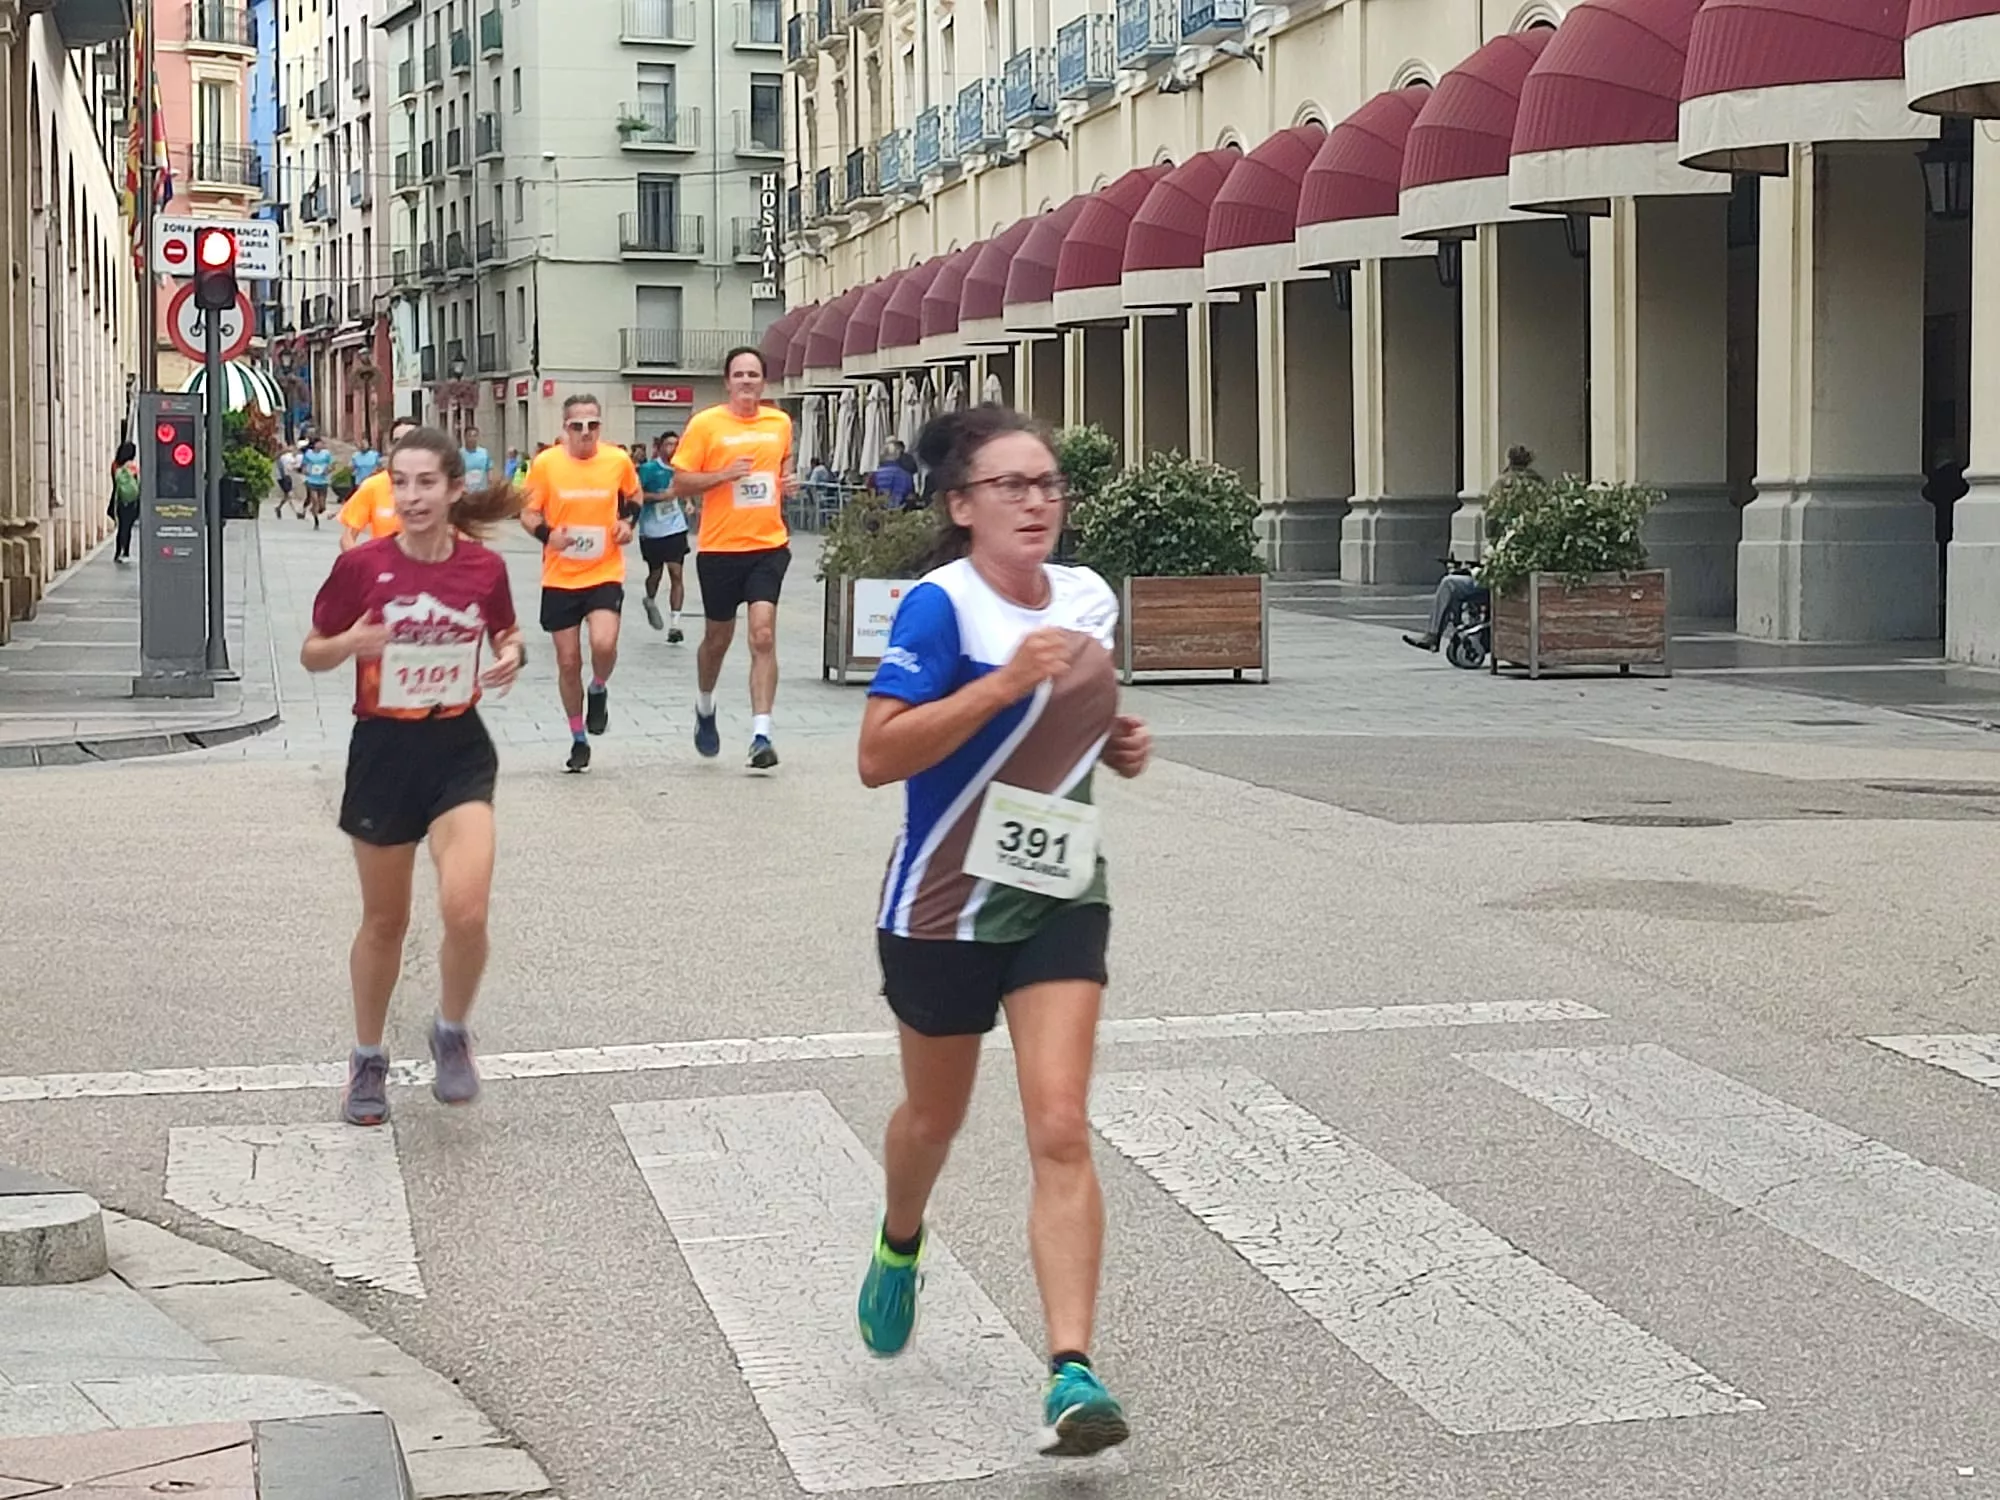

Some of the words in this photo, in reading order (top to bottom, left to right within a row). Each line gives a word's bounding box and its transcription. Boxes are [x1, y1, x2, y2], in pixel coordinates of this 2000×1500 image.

[163, 223, 192, 233] ZONA
[762, 173, 776, 279] HOSTAL
[396, 665, 460, 686] 1101
[998, 821, 1069, 864] 391
